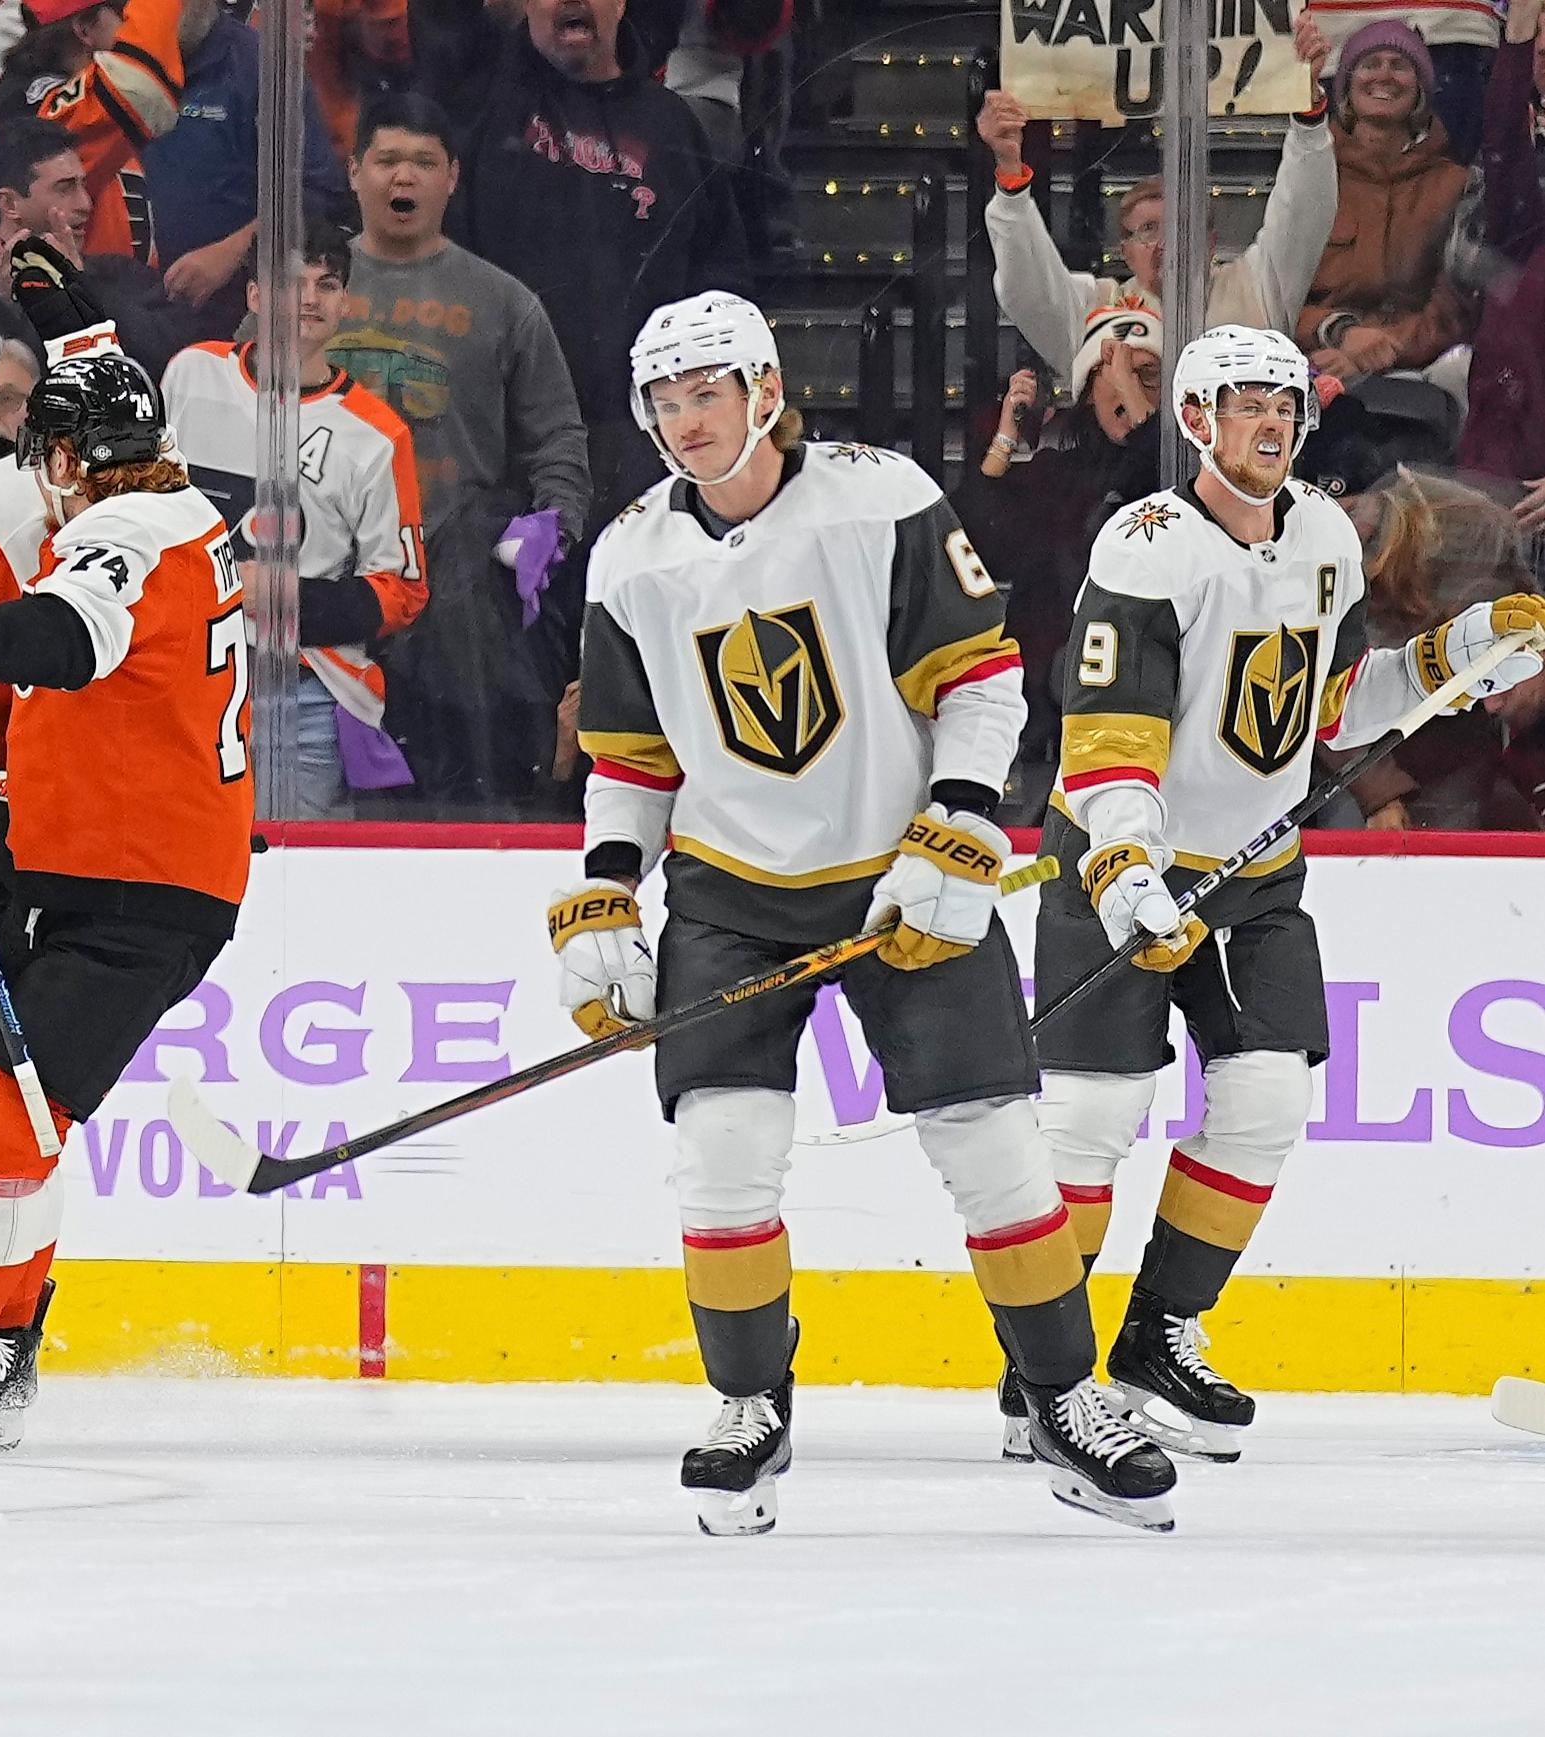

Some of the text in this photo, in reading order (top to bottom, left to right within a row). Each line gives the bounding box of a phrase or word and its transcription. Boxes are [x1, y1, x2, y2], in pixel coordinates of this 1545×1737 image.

[660, 315, 675, 329] 6
[129, 393, 154, 418] 74
[69, 545, 130, 593] 74
[1078, 621, 1119, 687] 9
[207, 607, 248, 784] 7
